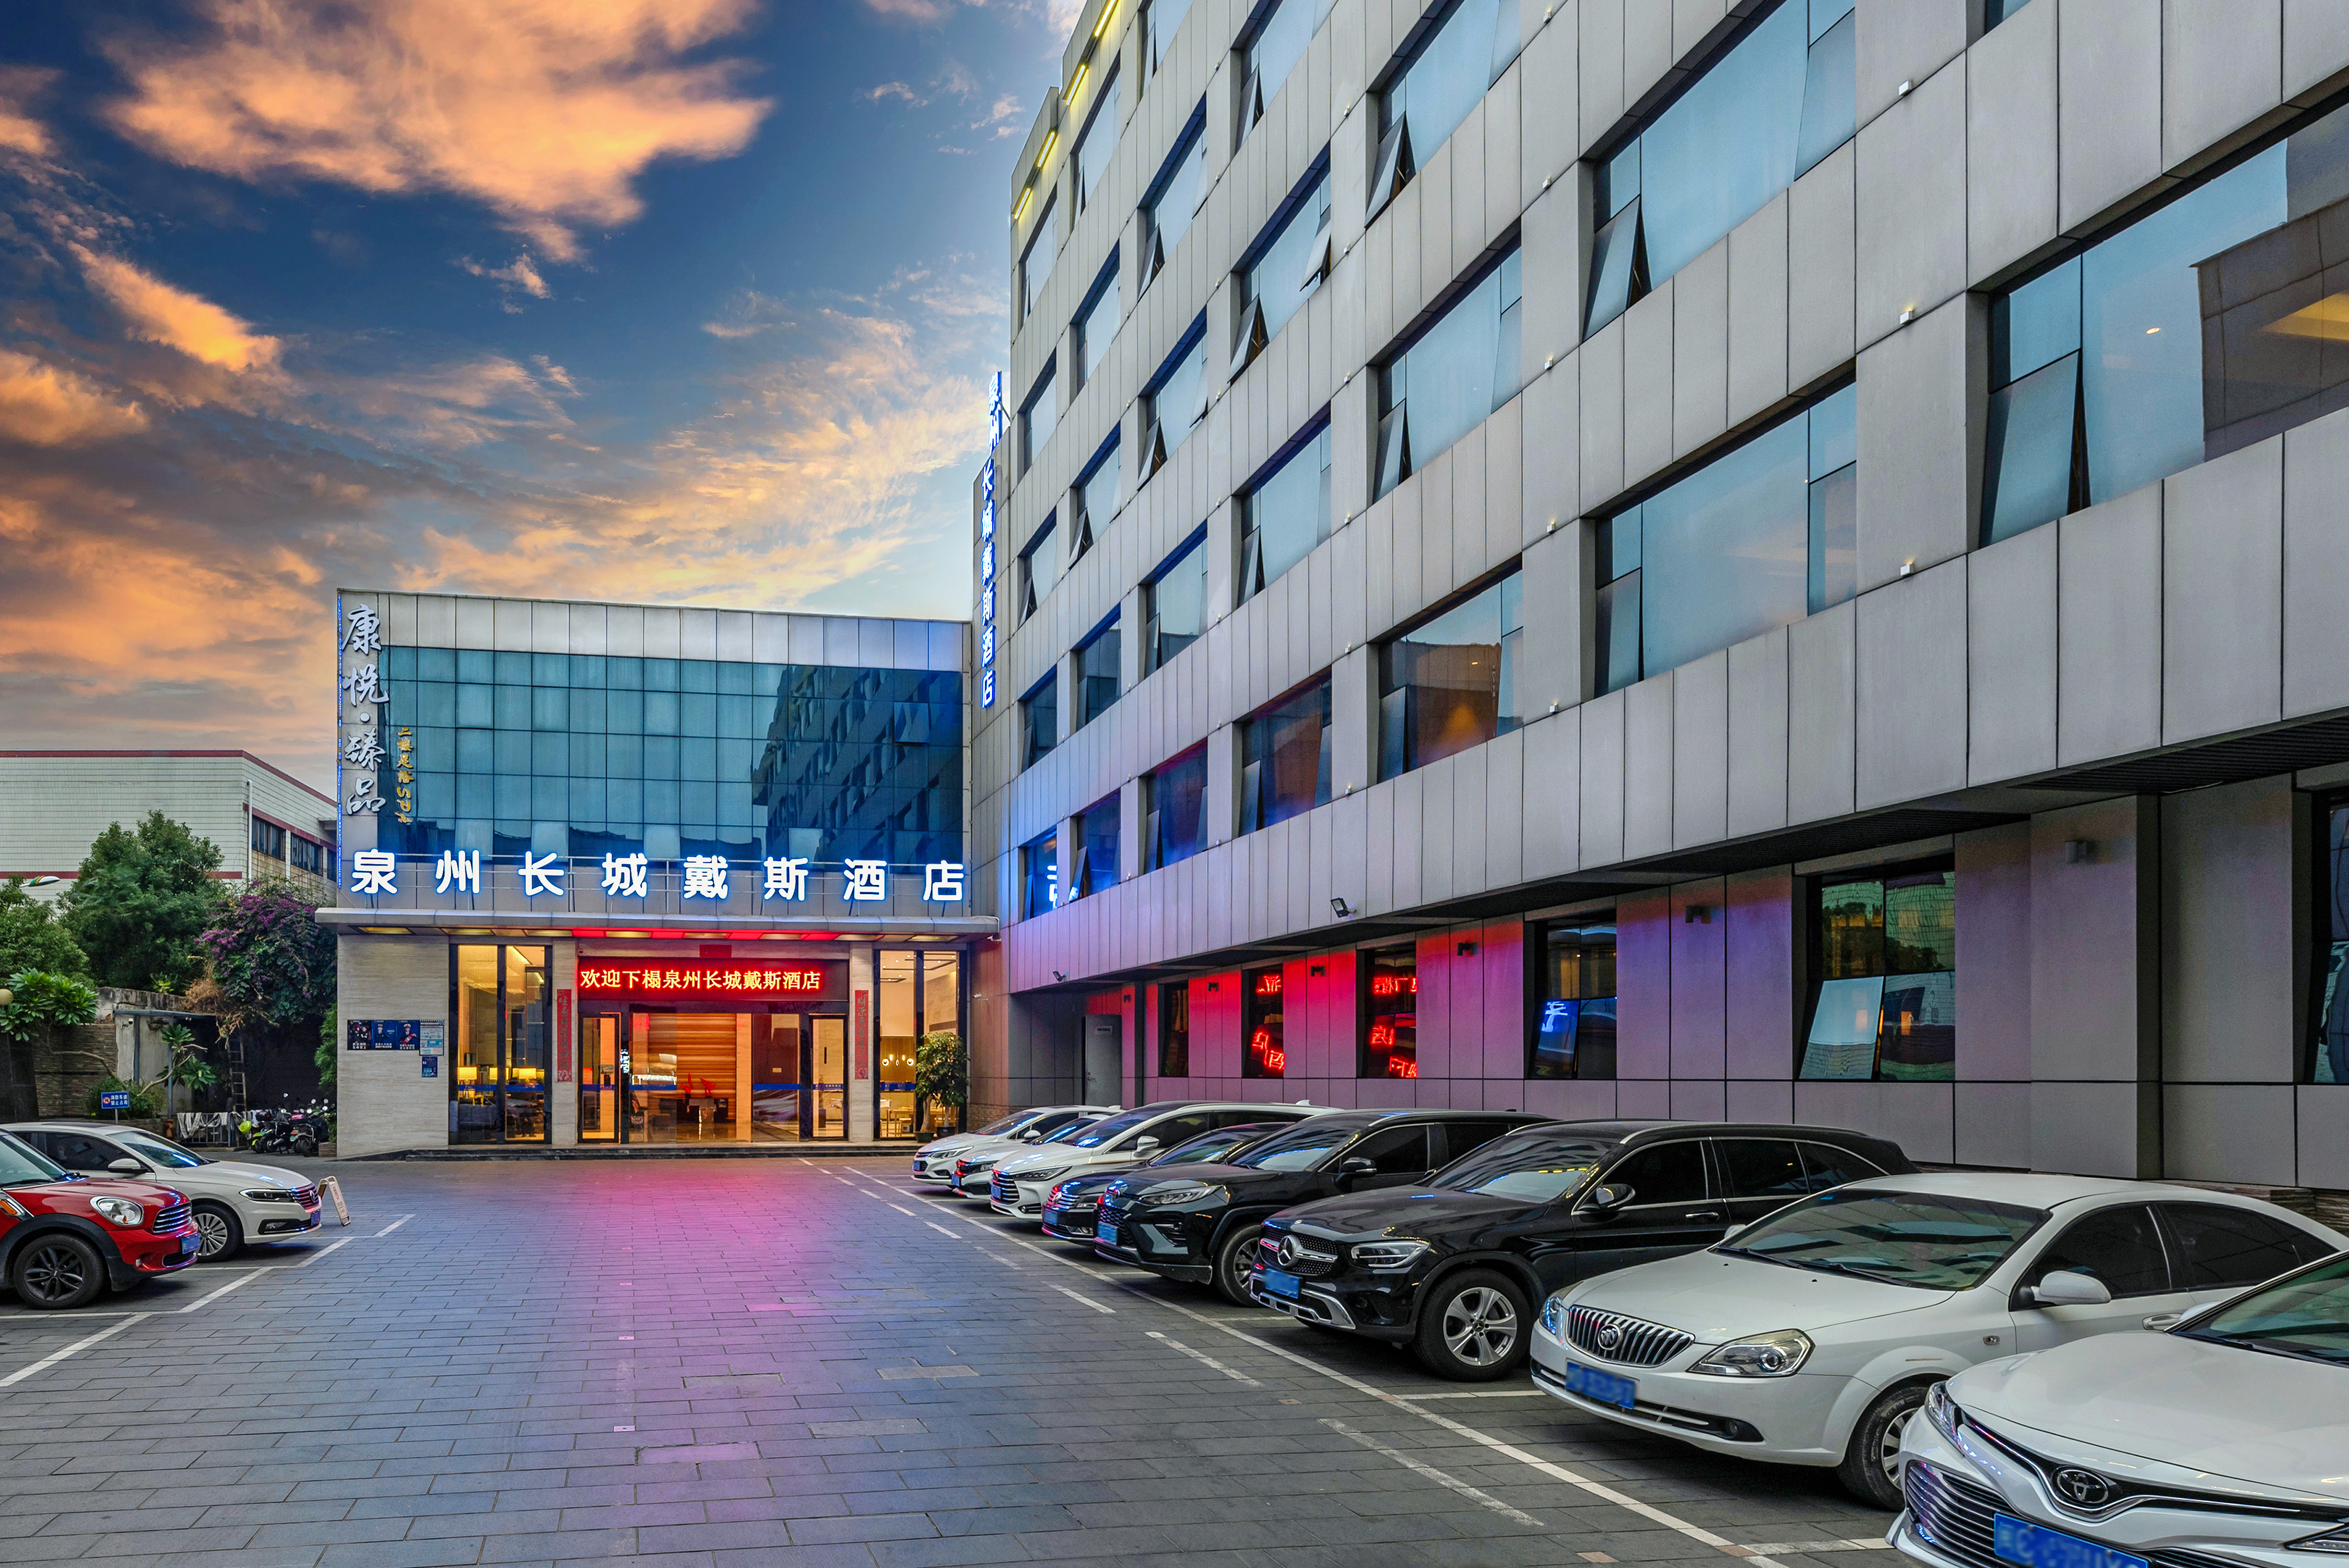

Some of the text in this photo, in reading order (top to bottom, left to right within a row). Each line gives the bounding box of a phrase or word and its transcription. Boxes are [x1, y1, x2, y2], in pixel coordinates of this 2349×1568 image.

[350, 849, 964, 901] 泉州长城戴斯酒店
[580, 969, 821, 990] 欢迎下榻泉州长城戴斯酒店
